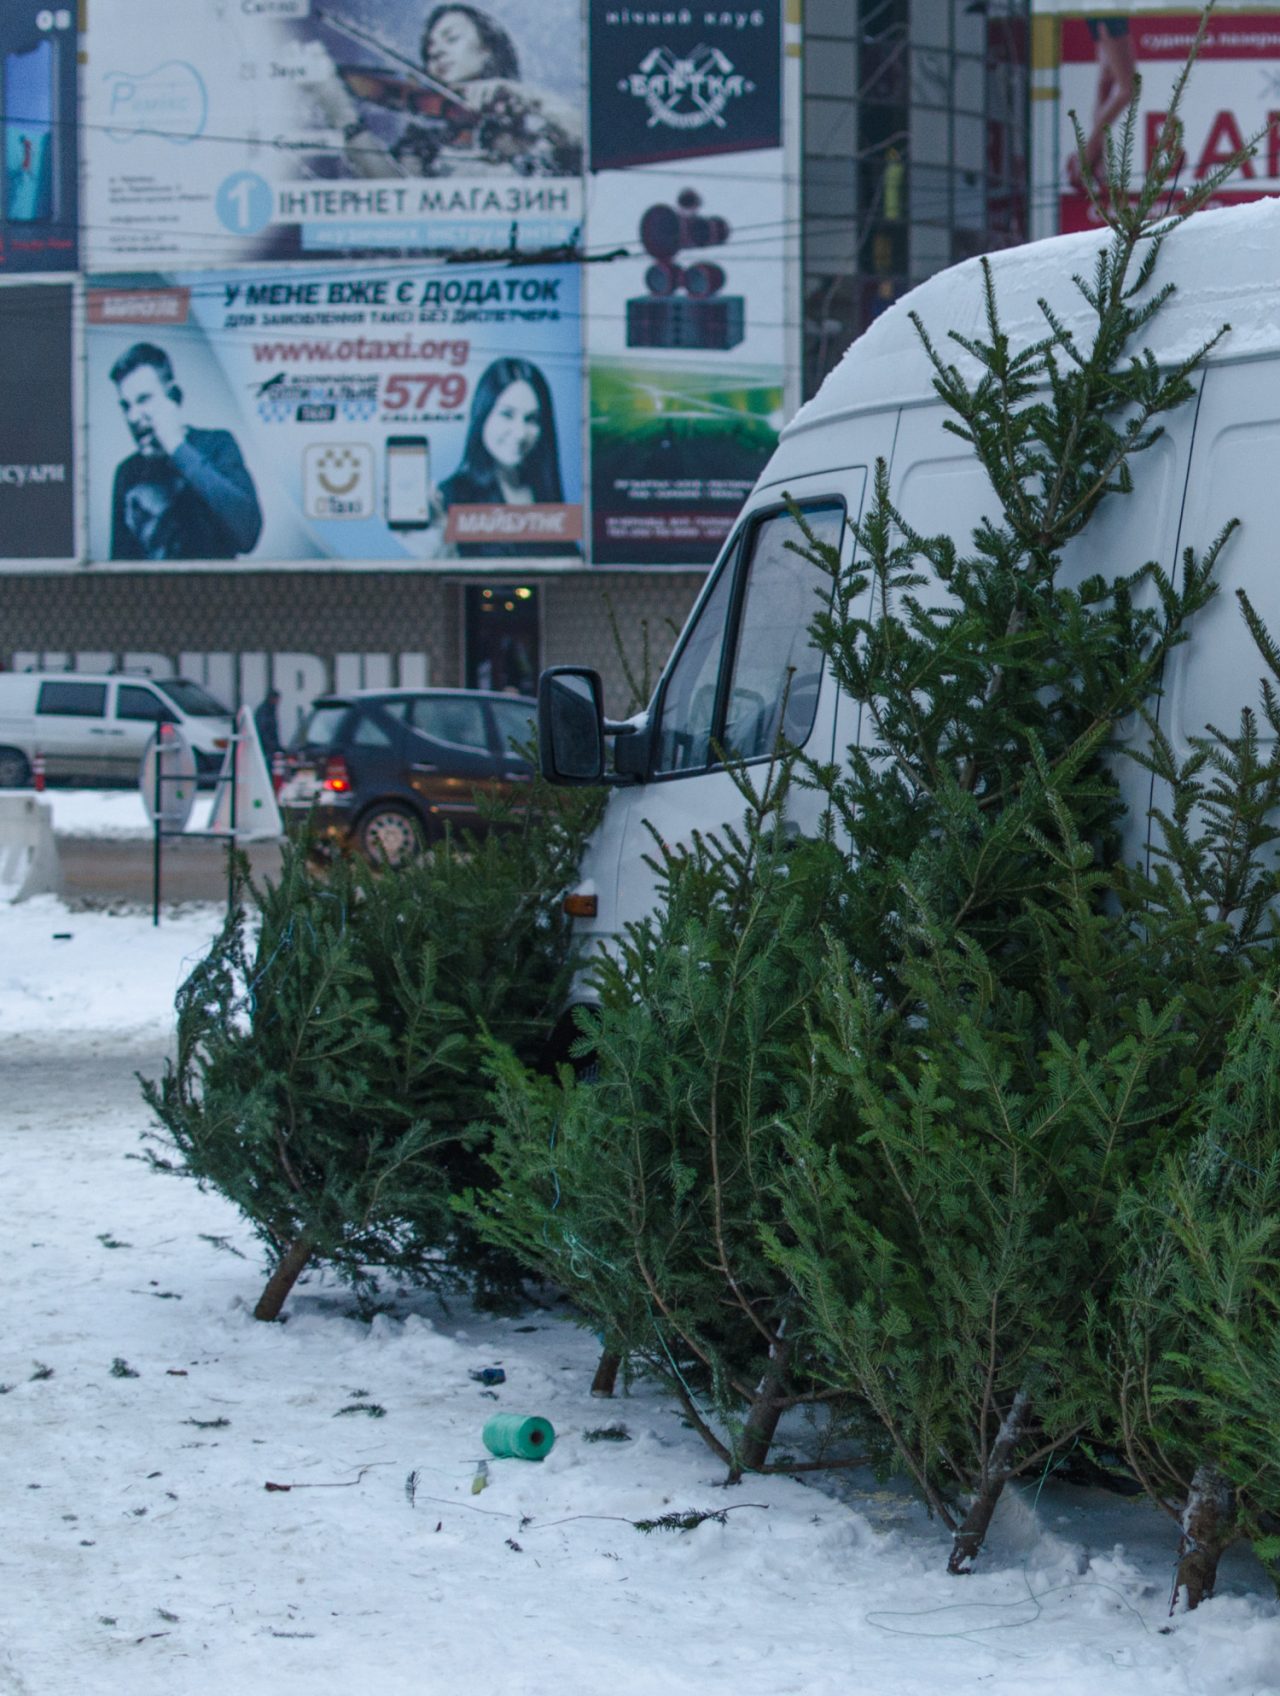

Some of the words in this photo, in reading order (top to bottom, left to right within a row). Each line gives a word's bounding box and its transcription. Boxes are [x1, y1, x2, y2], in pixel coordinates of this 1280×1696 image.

[704, 9, 764, 29] клуб
[279, 189, 408, 215] ІНТЕРНЕТ
[419, 188, 569, 213] МАГАЗИН
[224, 284, 241, 306] У
[246, 283, 320, 304] МЕНЕ
[327, 282, 388, 304] ВЖЕ
[395, 280, 415, 302] Є
[420, 278, 562, 307] ДОДАТОК
[419, 309, 449, 323] БЕЗ
[252, 333, 470, 367] www.otaxi.org
[381, 373, 468, 410] 579
